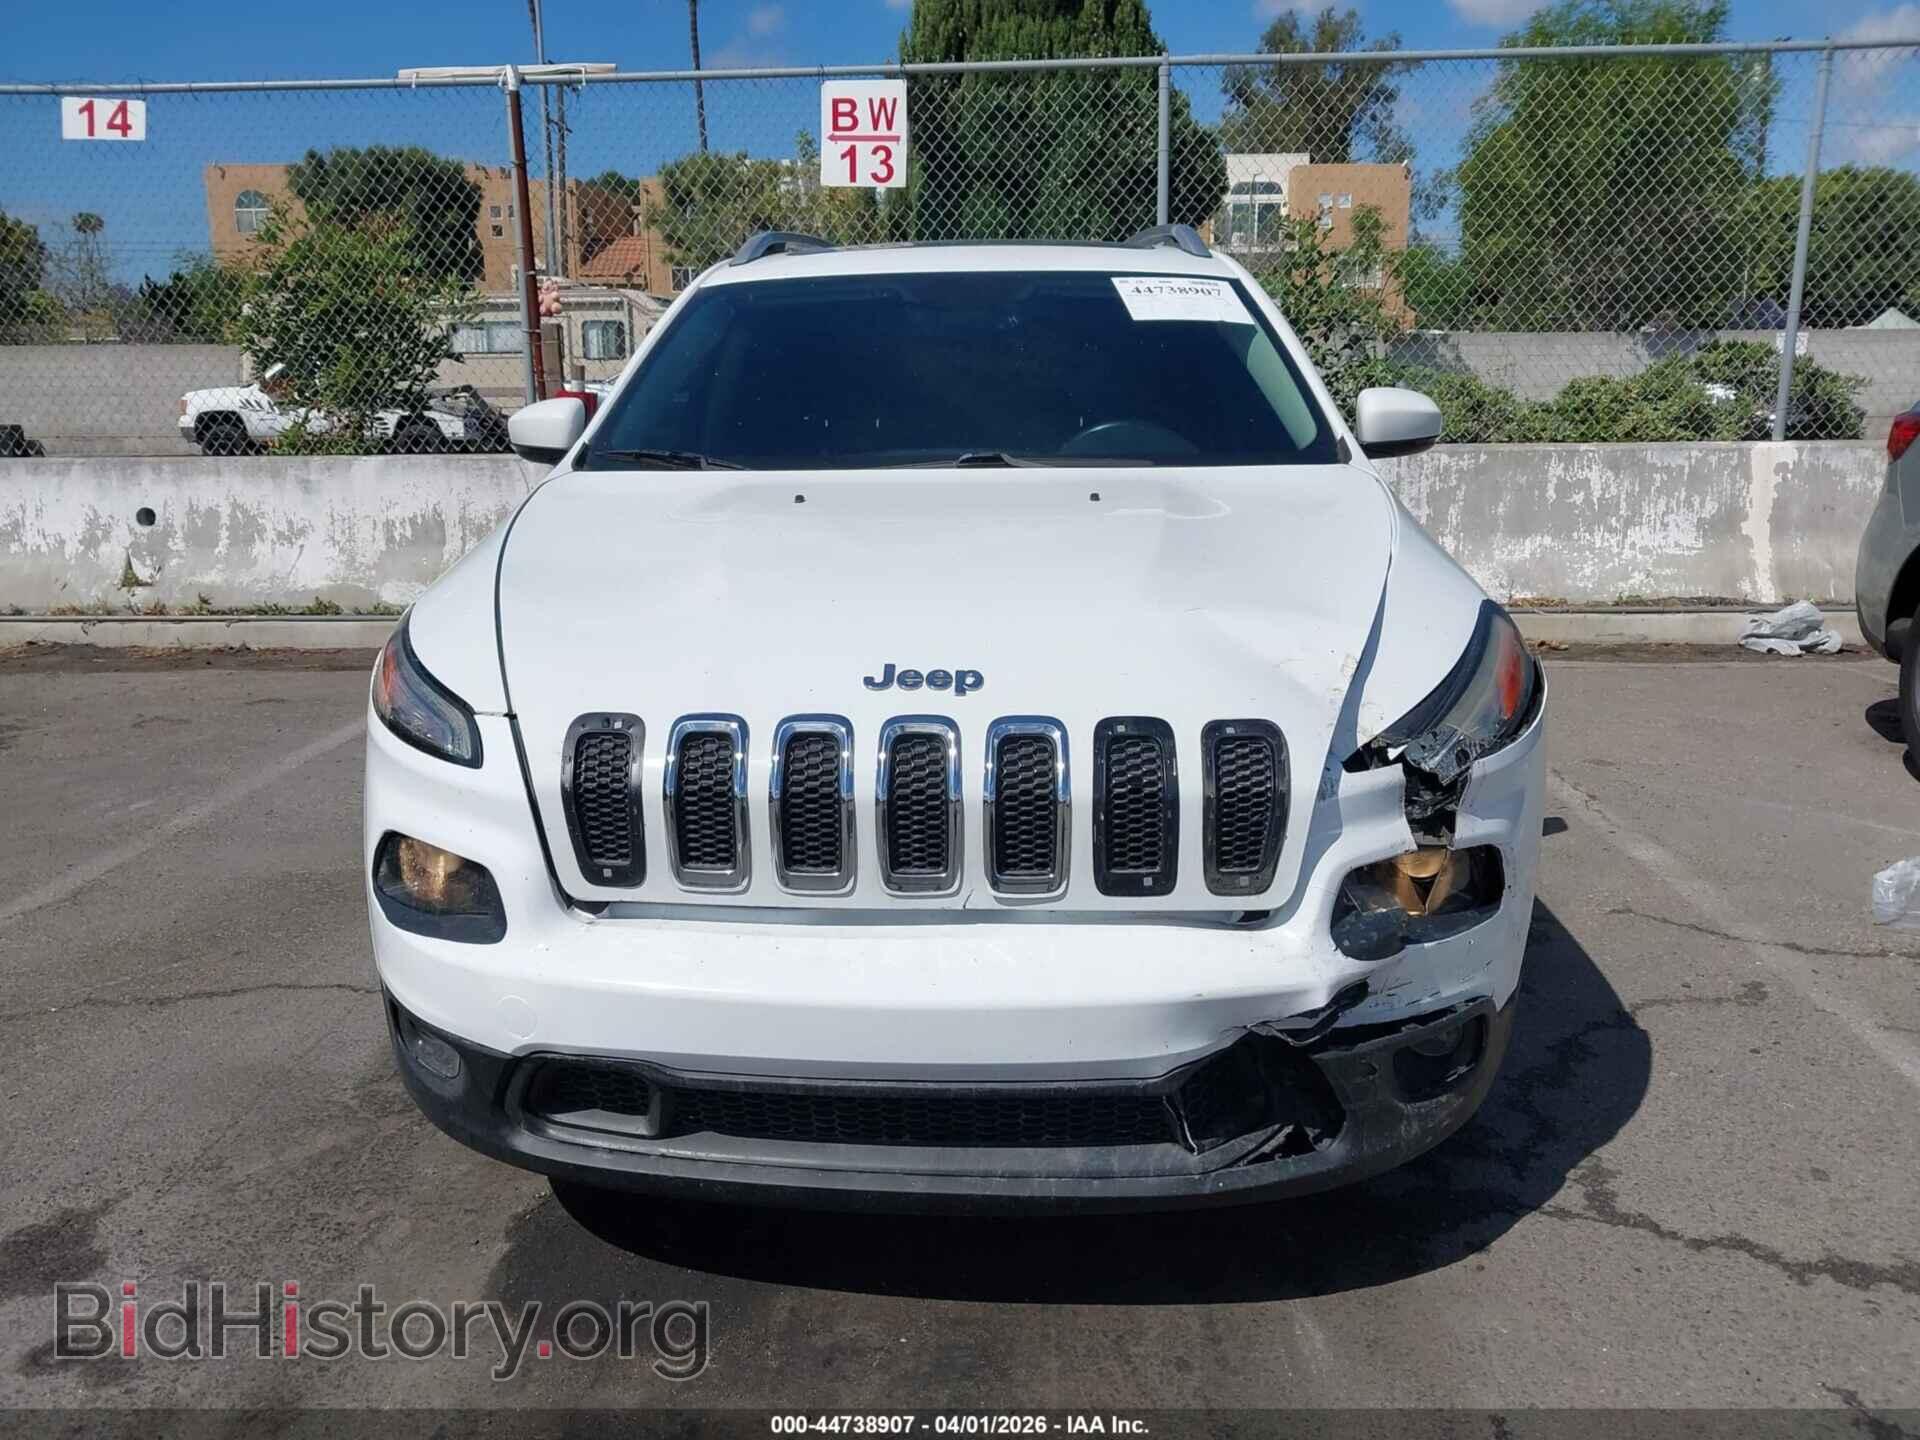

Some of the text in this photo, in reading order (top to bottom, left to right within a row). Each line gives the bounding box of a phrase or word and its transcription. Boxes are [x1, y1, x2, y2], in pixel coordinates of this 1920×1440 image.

[79, 99, 132, 137] 14
[840, 144, 894, 183] 13
[1131, 285, 1221, 296] 44738907
[863, 663, 984, 696] Jeep
